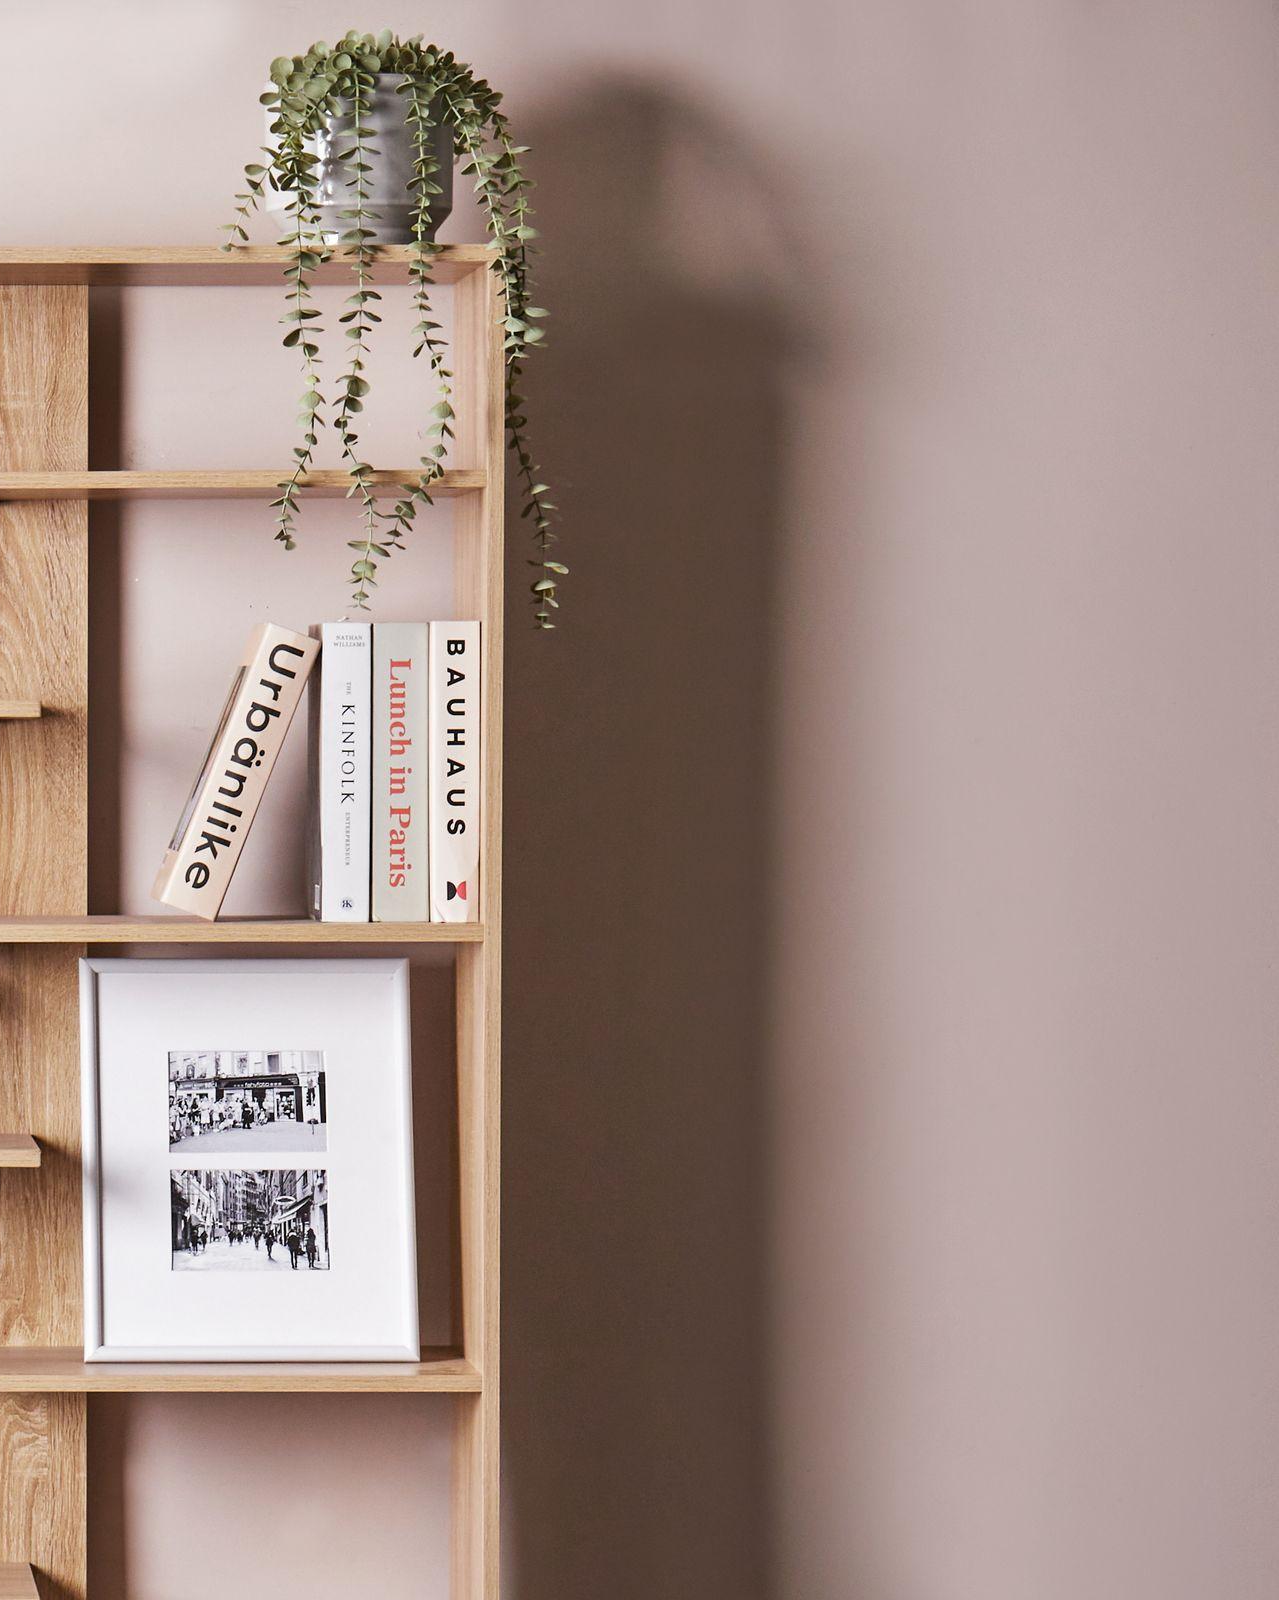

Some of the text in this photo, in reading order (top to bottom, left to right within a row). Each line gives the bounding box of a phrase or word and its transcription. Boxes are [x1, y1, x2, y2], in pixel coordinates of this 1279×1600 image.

[185, 643, 304, 889] Urbänlike
[340, 704, 356, 804] KINFOLK
[389, 658, 413, 888] Lunch in Paris
[446, 639, 466, 835] BAUHAUS
